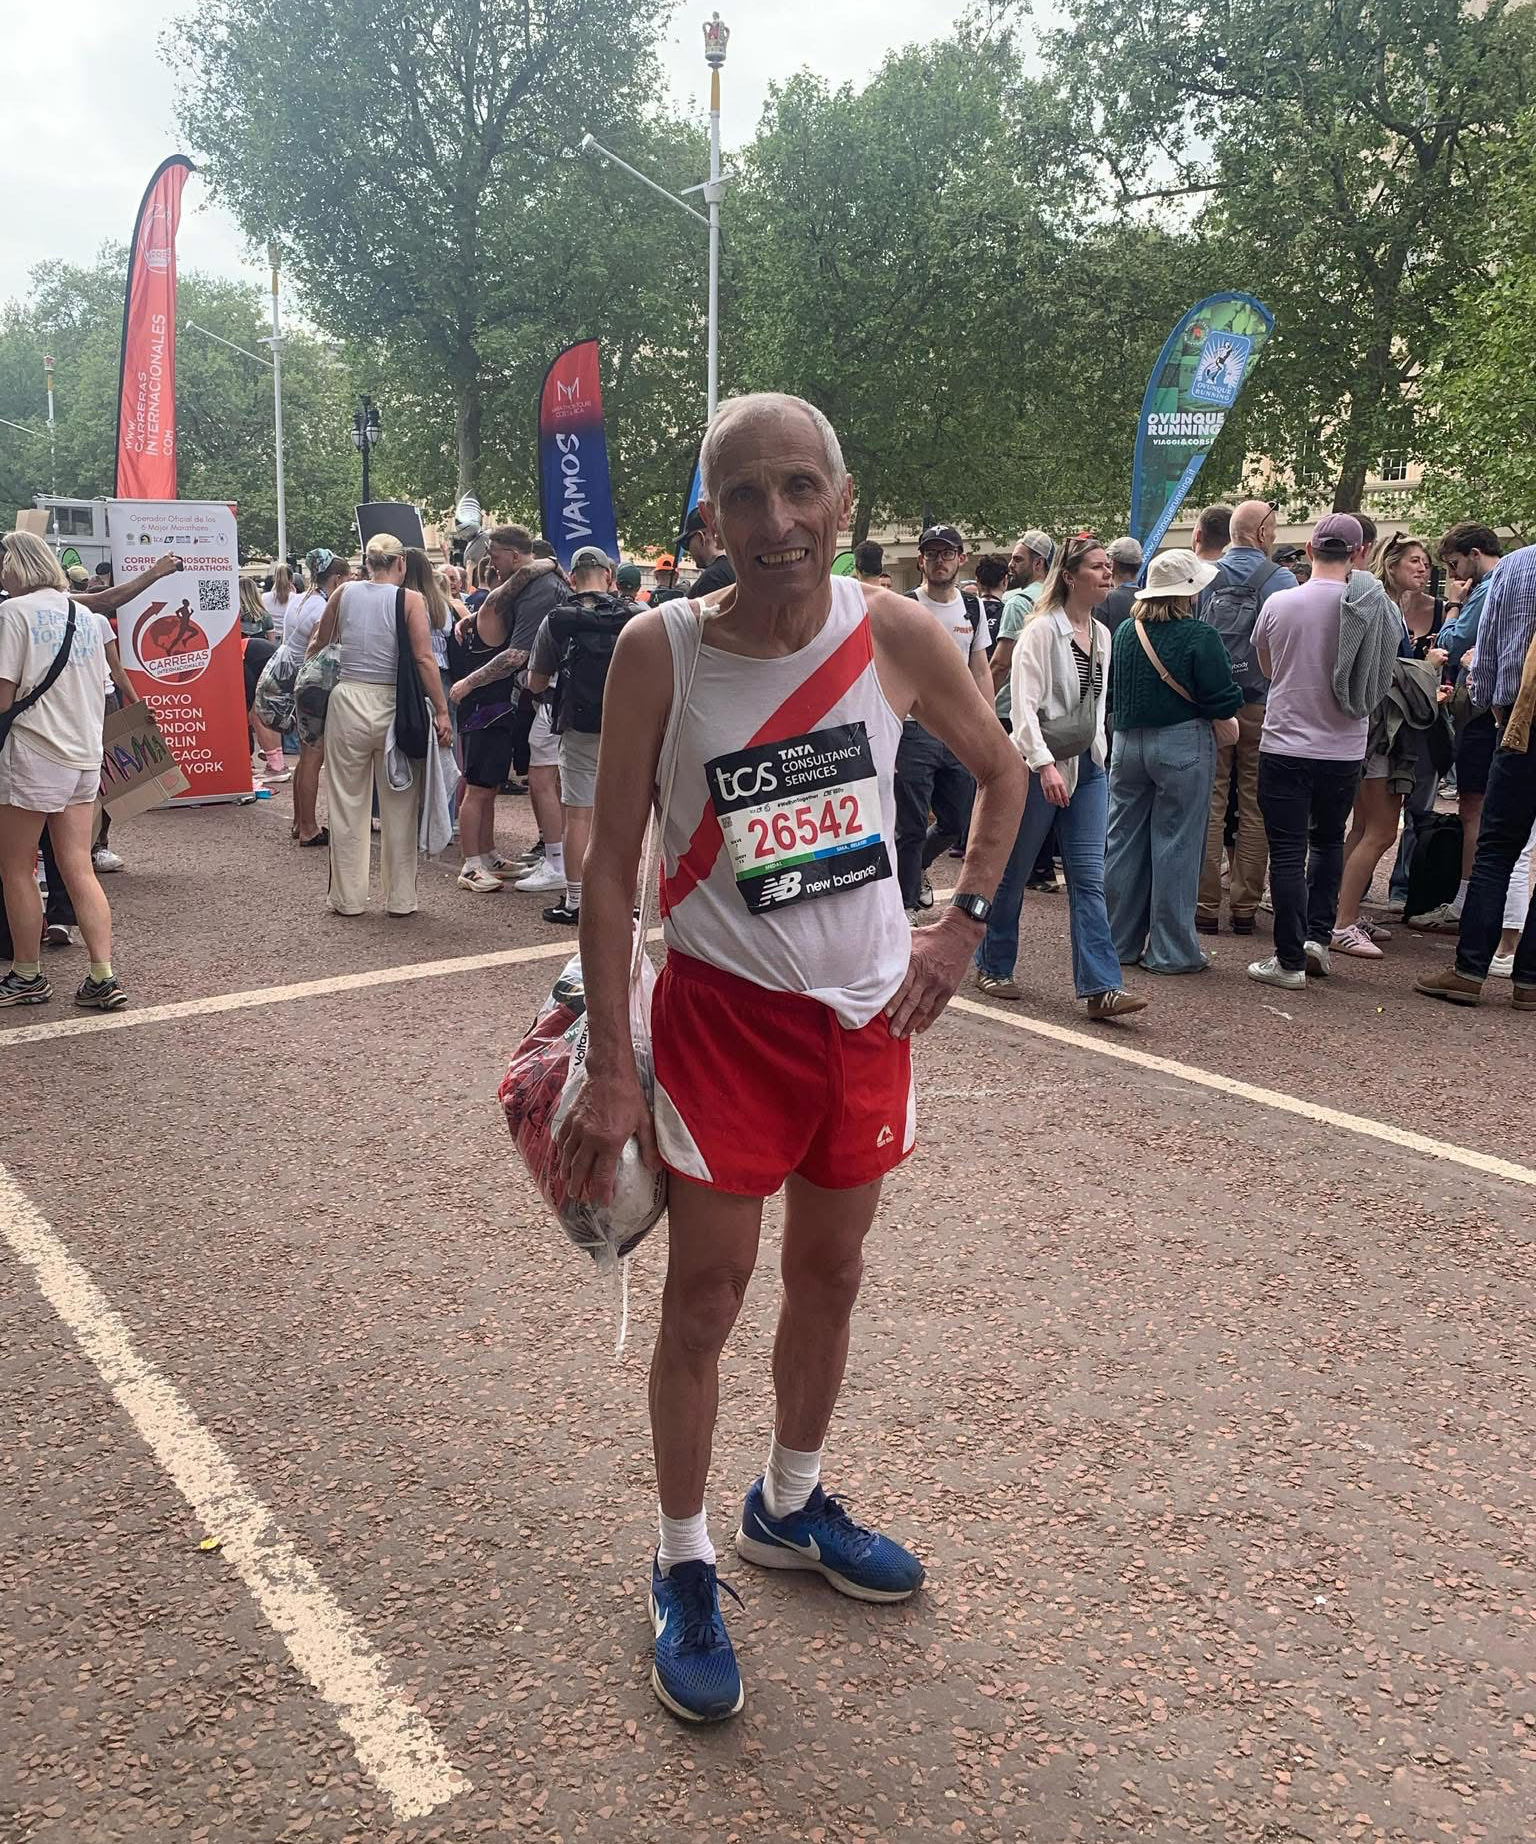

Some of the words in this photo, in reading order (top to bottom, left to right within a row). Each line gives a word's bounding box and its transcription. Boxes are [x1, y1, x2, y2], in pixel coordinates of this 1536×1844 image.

[145, 314, 166, 456] INTERNACIONALES
[134, 371, 147, 453] CARRERAS
[1147, 412, 1225, 424] OVUNQUE
[1147, 424, 1221, 436] RUNNING
[555, 433, 593, 541] VAMOS
[129, 514, 166, 523] Operador
[168, 514, 193, 522] Oficial
[1141, 468, 1196, 563] www.ovunquerunning.it
[124, 556, 156, 564] CORRE
[148, 650, 209, 671] CARRERAS
[157, 661, 205, 675] INTERNACIONALES
[142, 694, 192, 706] TOKYO
[154, 708, 203, 720] OSTON
[165, 735, 197, 748] RLIN
[171, 748, 212, 761] CAGO
[778, 743, 815, 761] TATA
[781, 745, 862, 774] CONSULTANCY
[184, 761, 224, 774] YORK
[784, 765, 838, 787] SERVICES
[747, 794, 863, 859] 26542
[806, 875, 831, 894] new
[833, 864, 877, 886] balance
